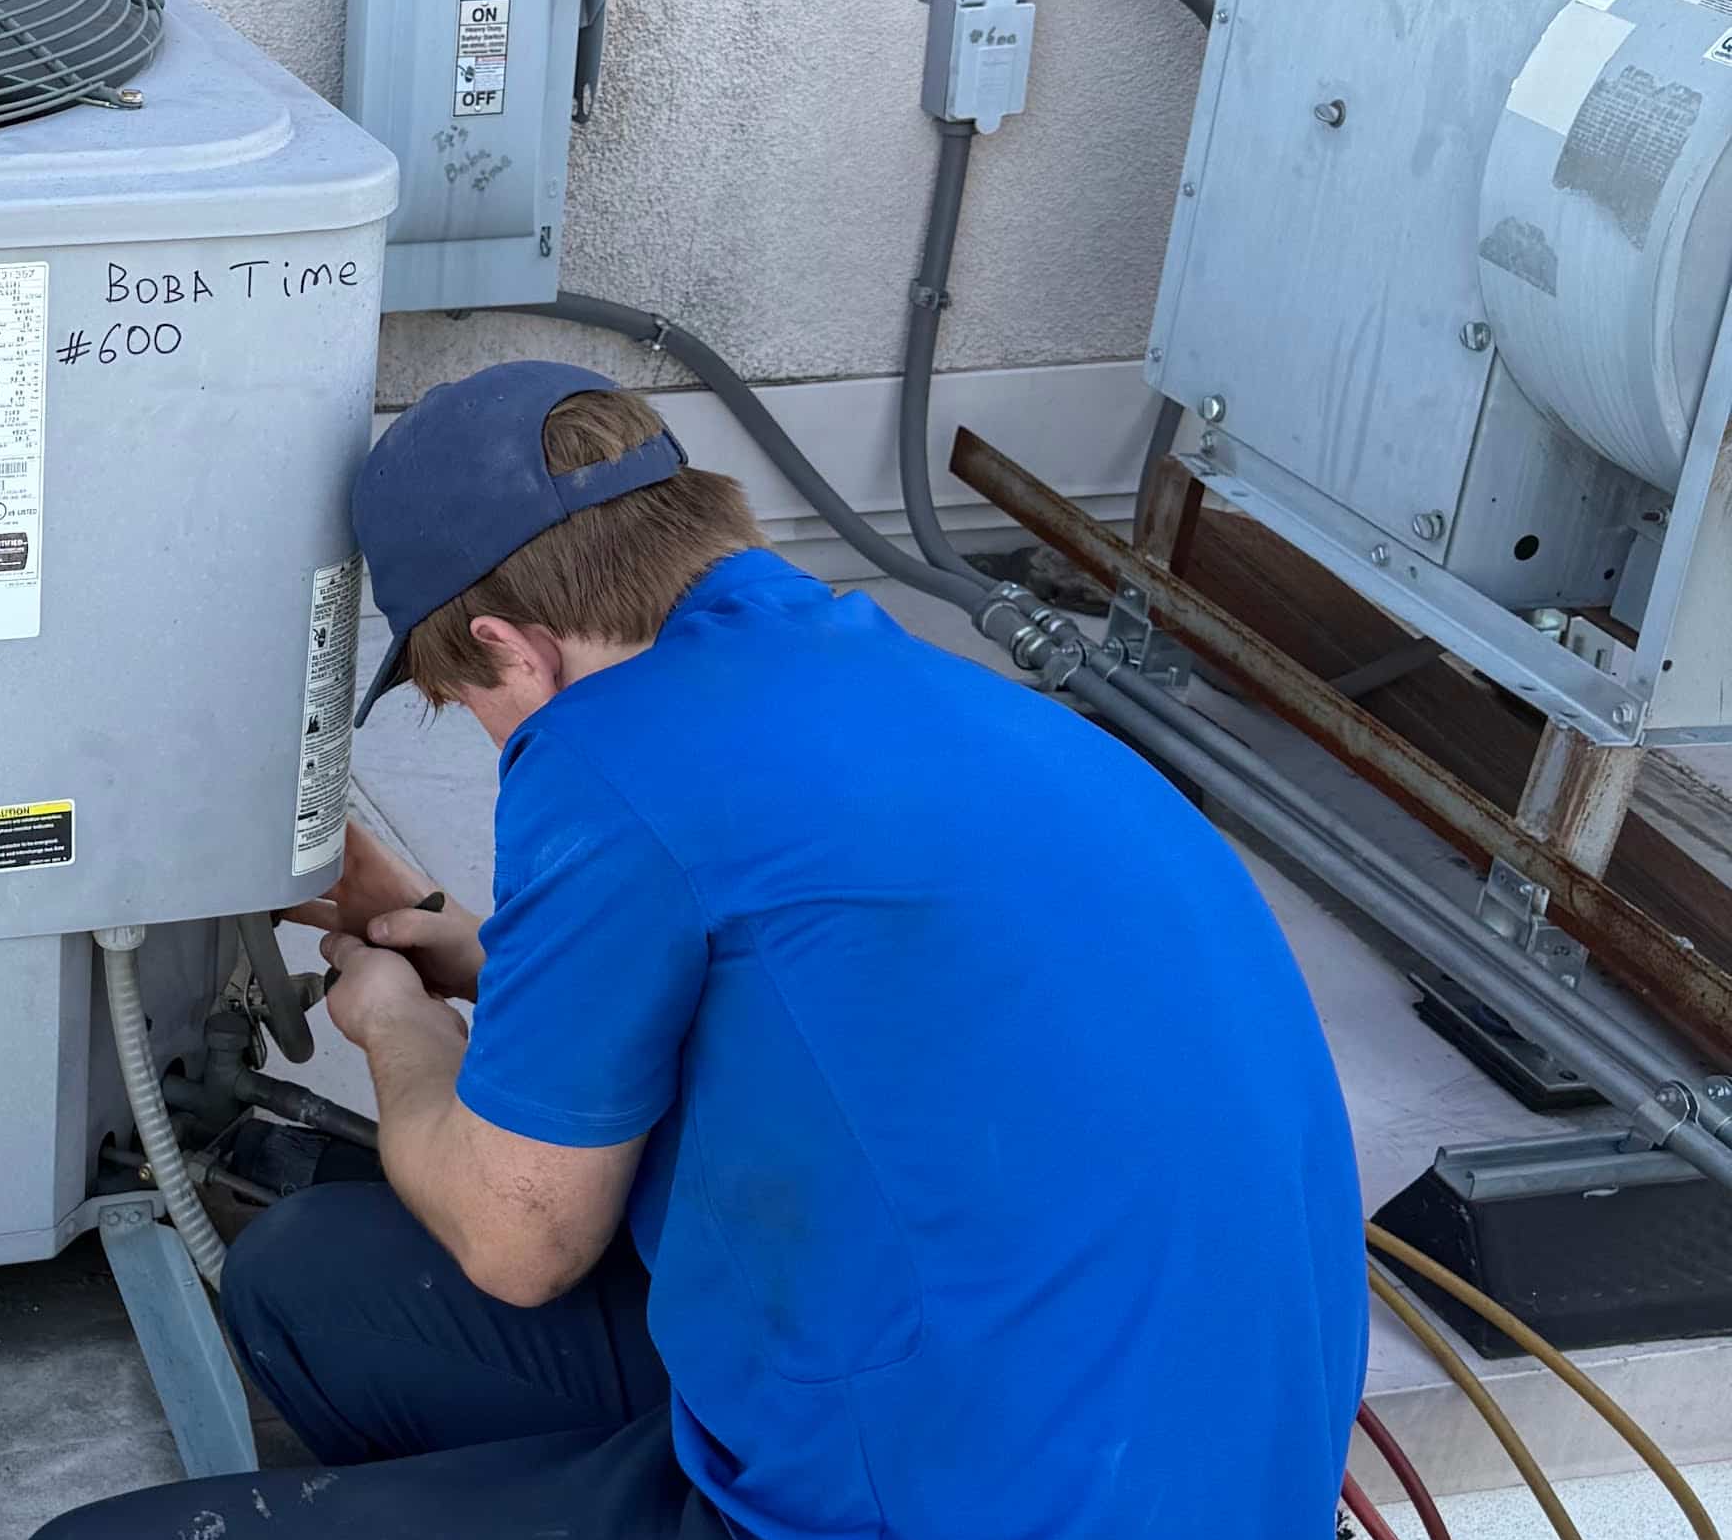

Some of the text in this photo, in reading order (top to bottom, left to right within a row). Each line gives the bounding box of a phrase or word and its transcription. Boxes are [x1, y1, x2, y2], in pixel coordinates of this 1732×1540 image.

[471, 6, 498, 23] ON
[461, 90, 497, 107] OFF
[105, 260, 358, 304] BOBA Time
[55, 322, 183, 366] #600
